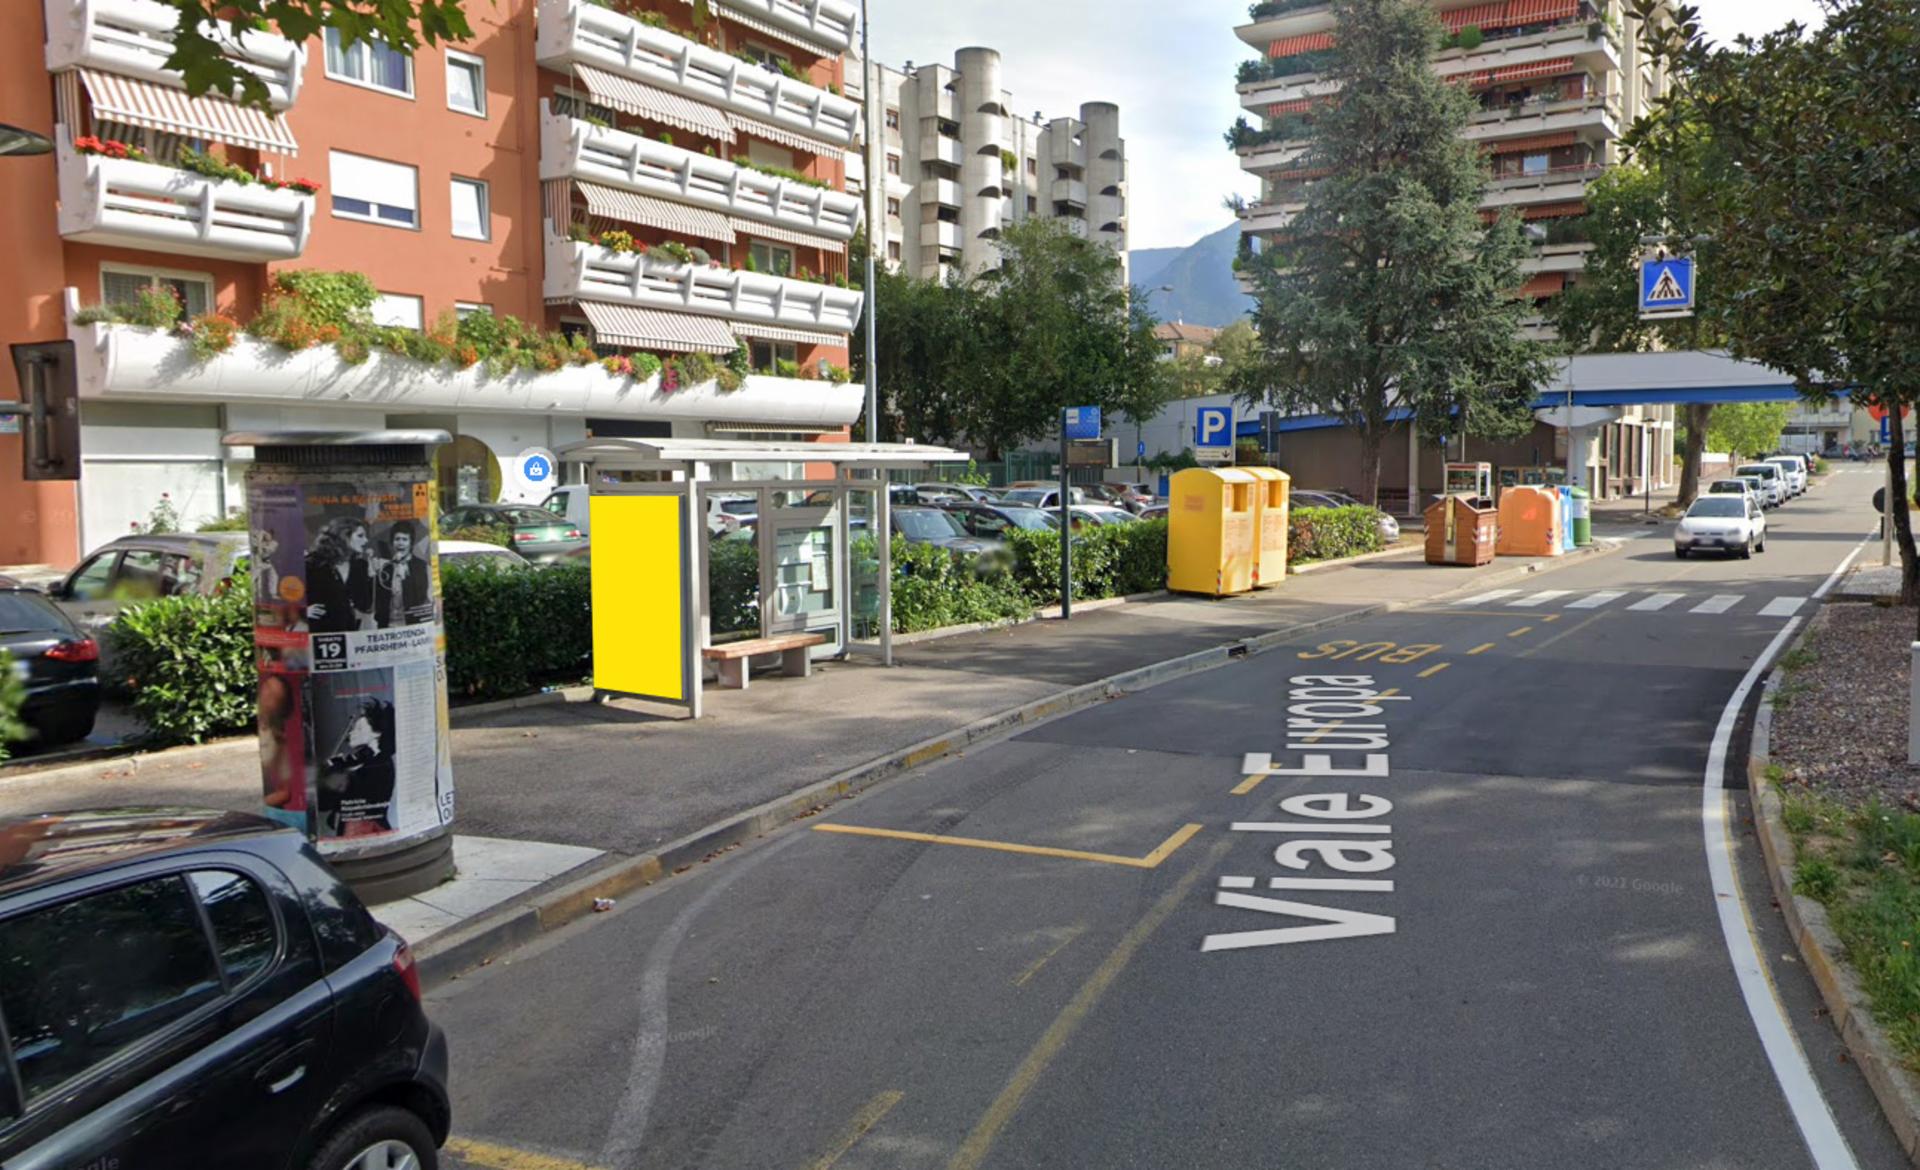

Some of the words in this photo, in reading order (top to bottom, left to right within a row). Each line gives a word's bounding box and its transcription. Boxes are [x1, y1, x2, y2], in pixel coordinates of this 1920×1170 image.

[1202, 410, 1225, 444] P
[366, 628, 426, 643] TEATROTENDA
[318, 642, 341, 658] 19
[354, 640, 408, 654] PFARRHEIM
[1296, 639, 1443, 664] BUS
